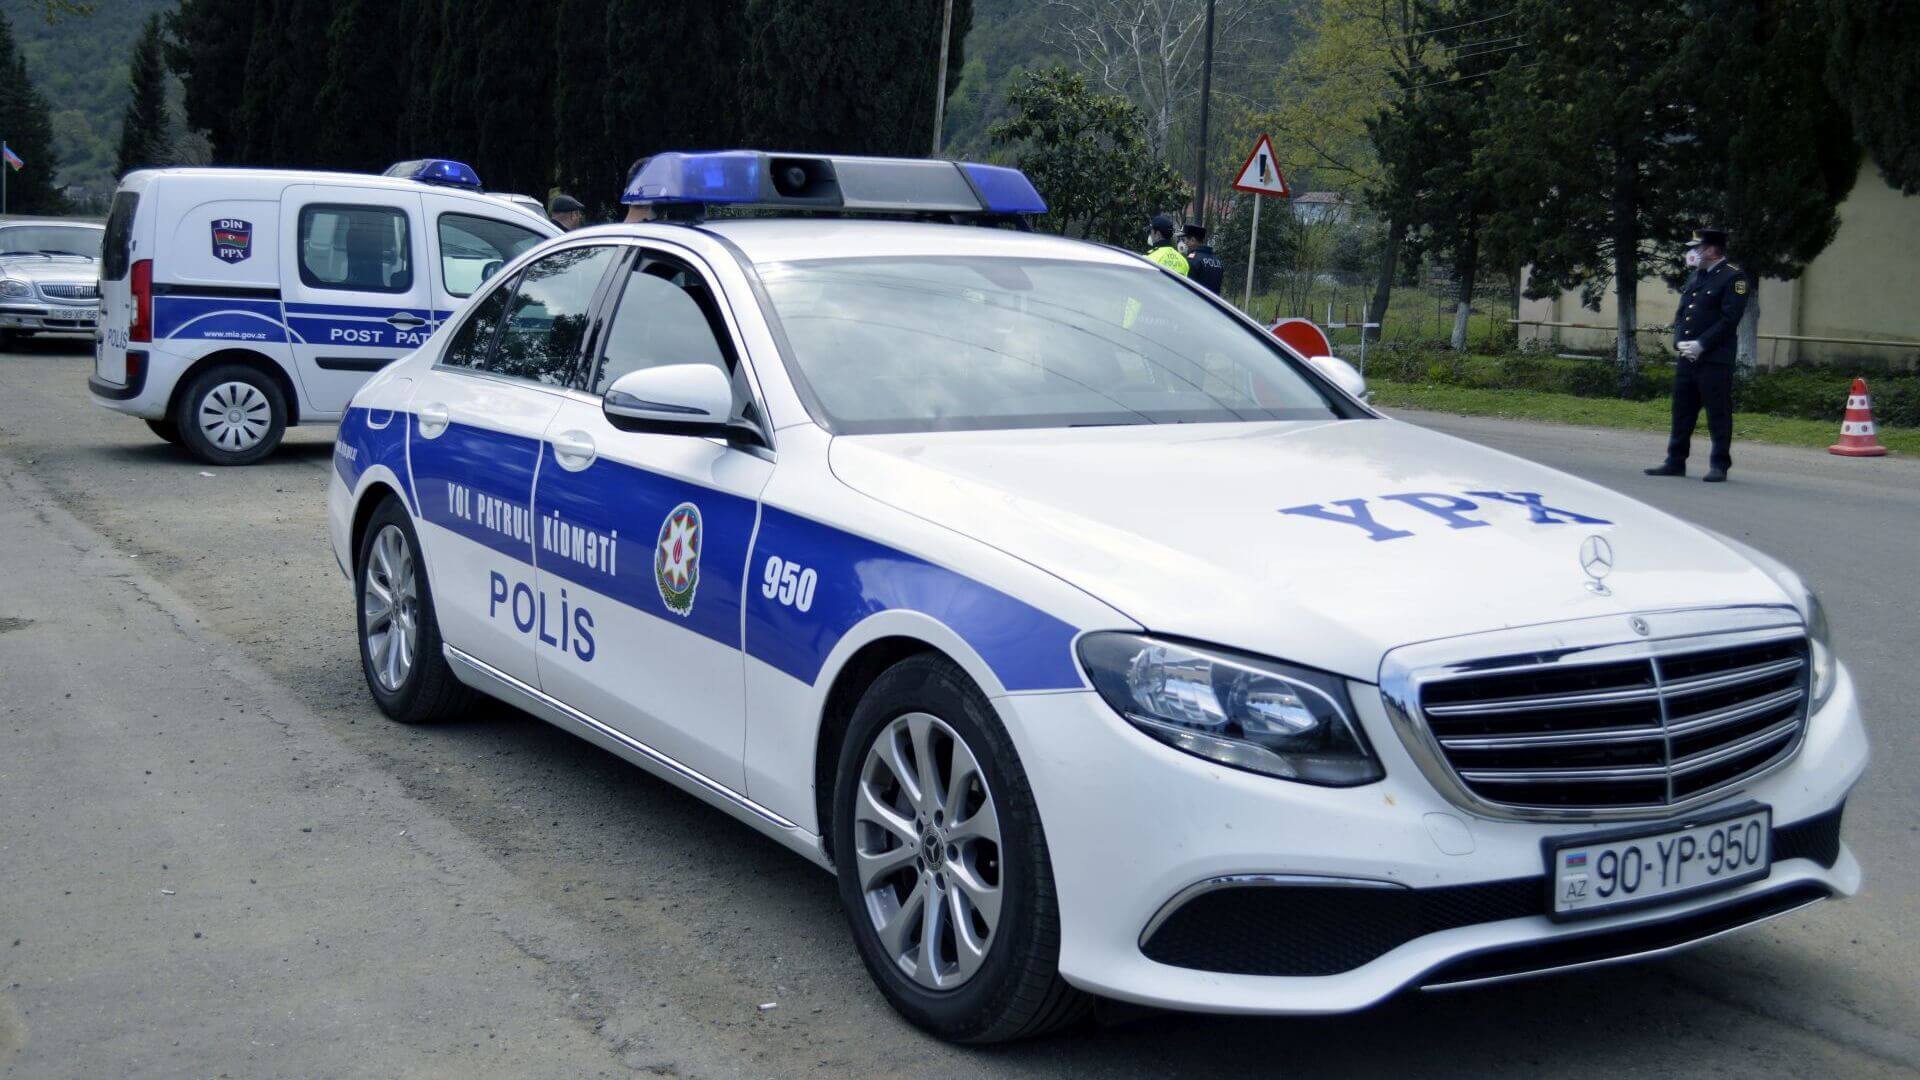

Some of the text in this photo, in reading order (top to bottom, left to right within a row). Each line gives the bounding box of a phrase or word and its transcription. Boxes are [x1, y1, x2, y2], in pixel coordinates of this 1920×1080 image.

[221, 248, 244, 258] PPX
[330, 328, 384, 343] POST
[448, 482, 617, 576] YOL PATRUL XİDMƏTİ
[1277, 491, 1615, 542] YPX
[762, 555, 818, 613] 950
[490, 569, 596, 662] POLİS
[1566, 819, 1762, 898] AZ 90-YP-950
